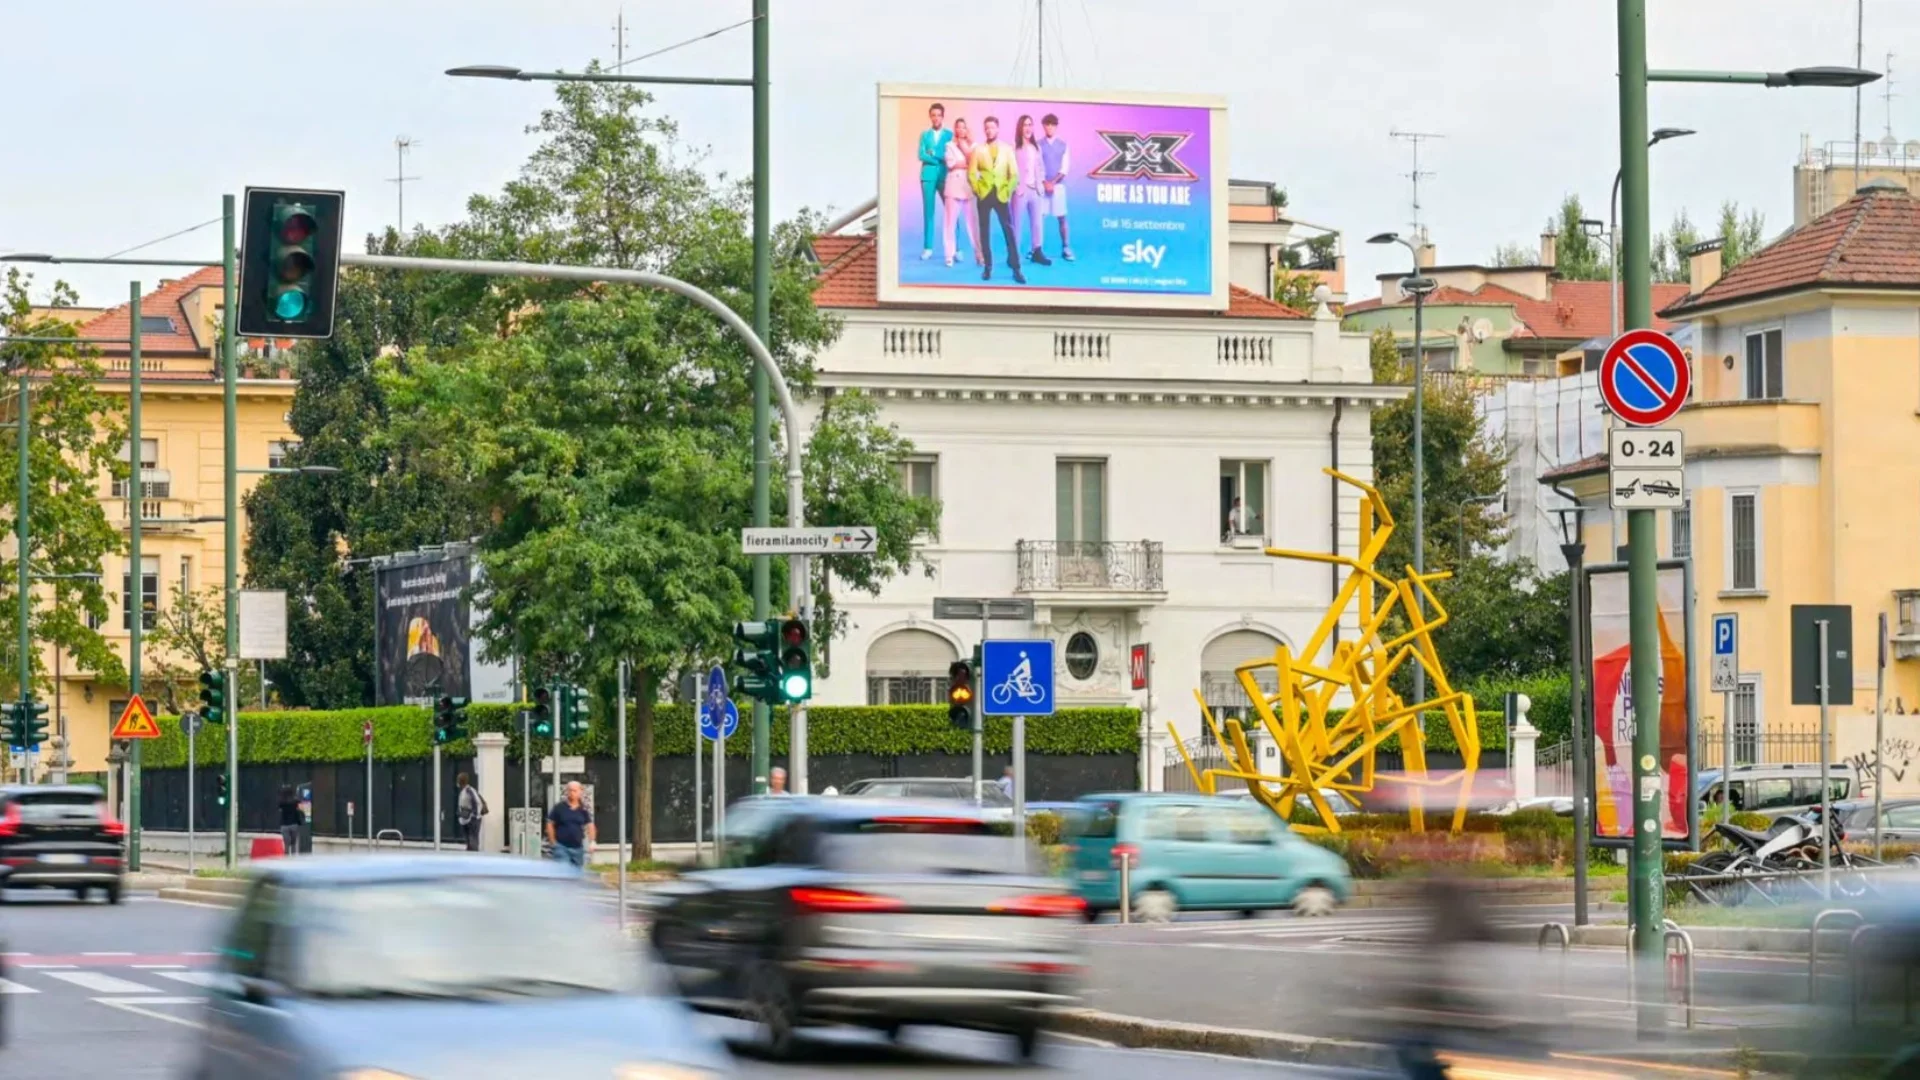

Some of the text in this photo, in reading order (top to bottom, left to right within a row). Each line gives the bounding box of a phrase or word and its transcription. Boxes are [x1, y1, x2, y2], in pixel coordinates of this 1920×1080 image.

[1097, 183, 1191, 206] COME AS YOU ARE
[1133, 219, 1185, 231] settembre
[1122, 239, 1166, 269] sky
[746, 534, 829, 548] fieramilanocity
[1719, 622, 1731, 650] P
[1133, 655, 1145, 681] M
